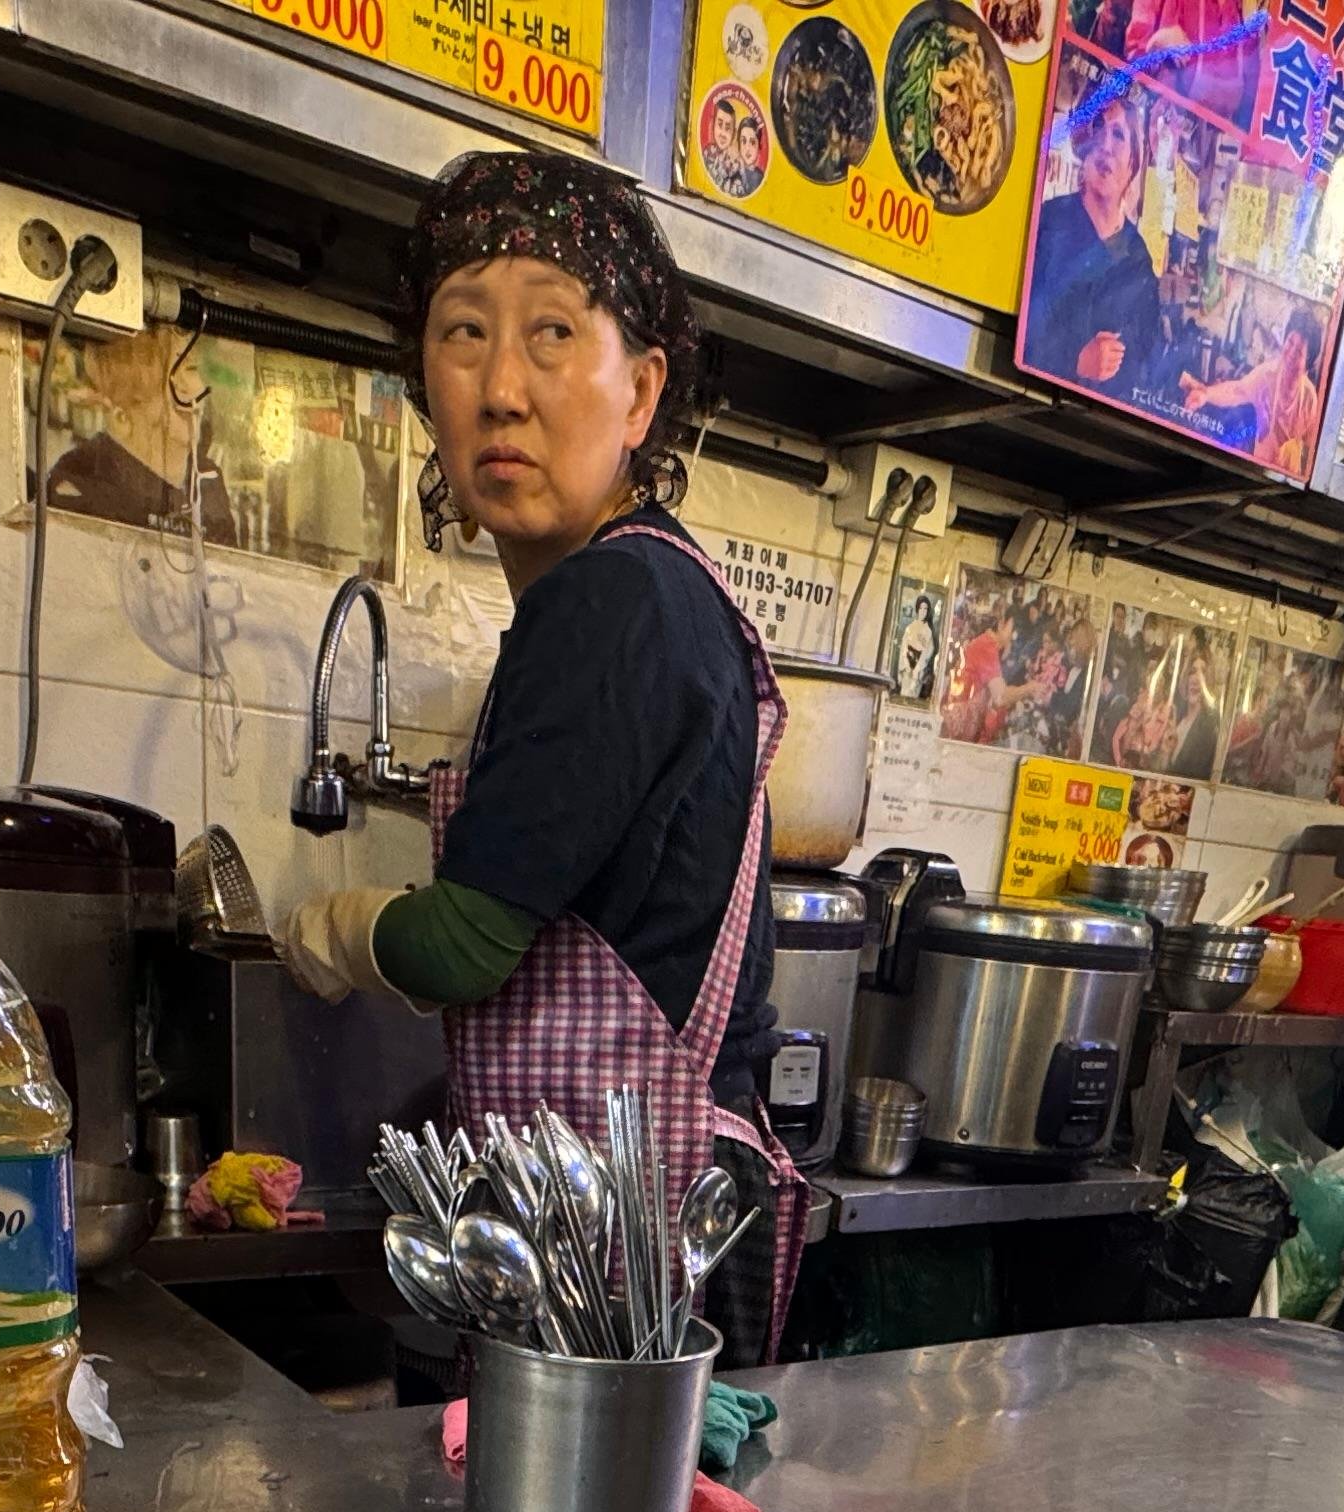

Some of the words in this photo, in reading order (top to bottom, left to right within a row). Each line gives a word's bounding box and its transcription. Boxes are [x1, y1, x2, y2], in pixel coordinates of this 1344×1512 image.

[261, 0, 384, 50] .000
[483, 37, 591, 124] 9.000
[848, 174, 930, 247] 9.000
